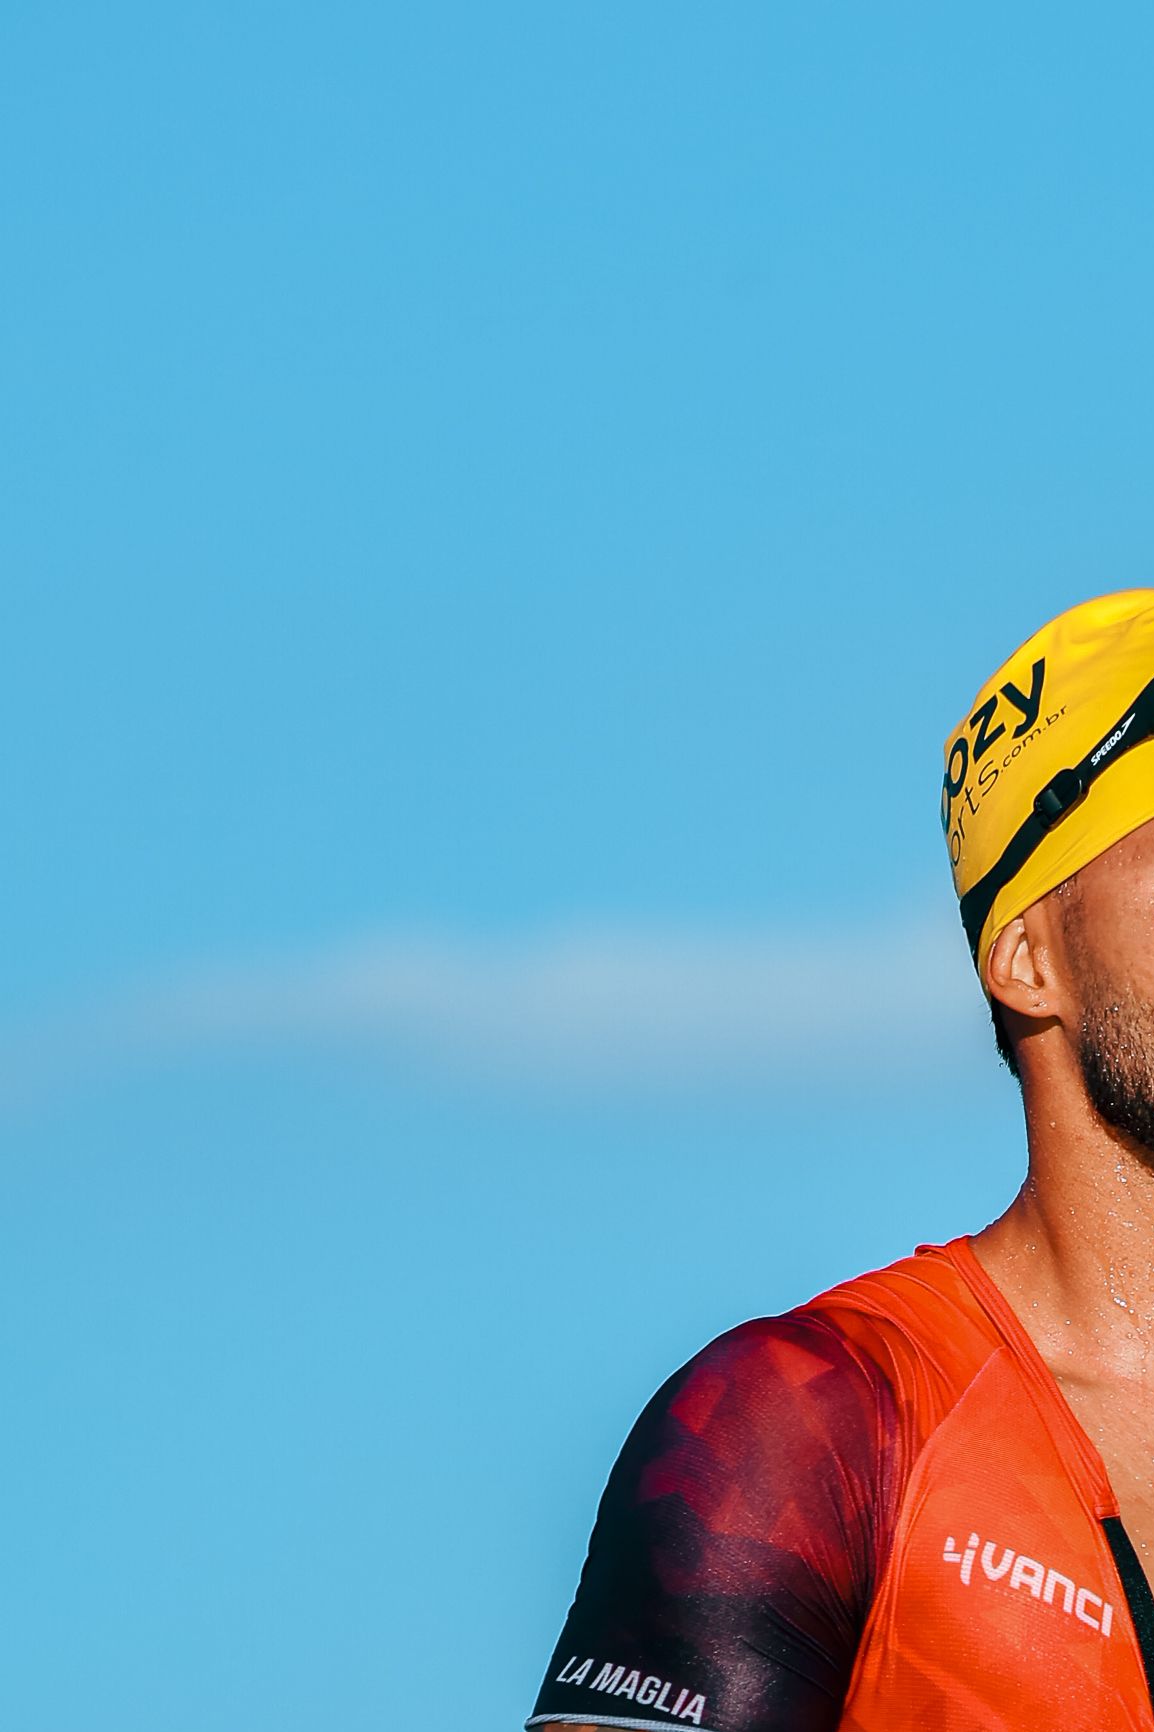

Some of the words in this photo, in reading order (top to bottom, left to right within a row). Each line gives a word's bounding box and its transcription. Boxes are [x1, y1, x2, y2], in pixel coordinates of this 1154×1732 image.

[1090, 730, 1122, 767] SPEEDO
[556, 1656, 595, 1686] LA
[589, 1662, 708, 1726] MAGLIA
